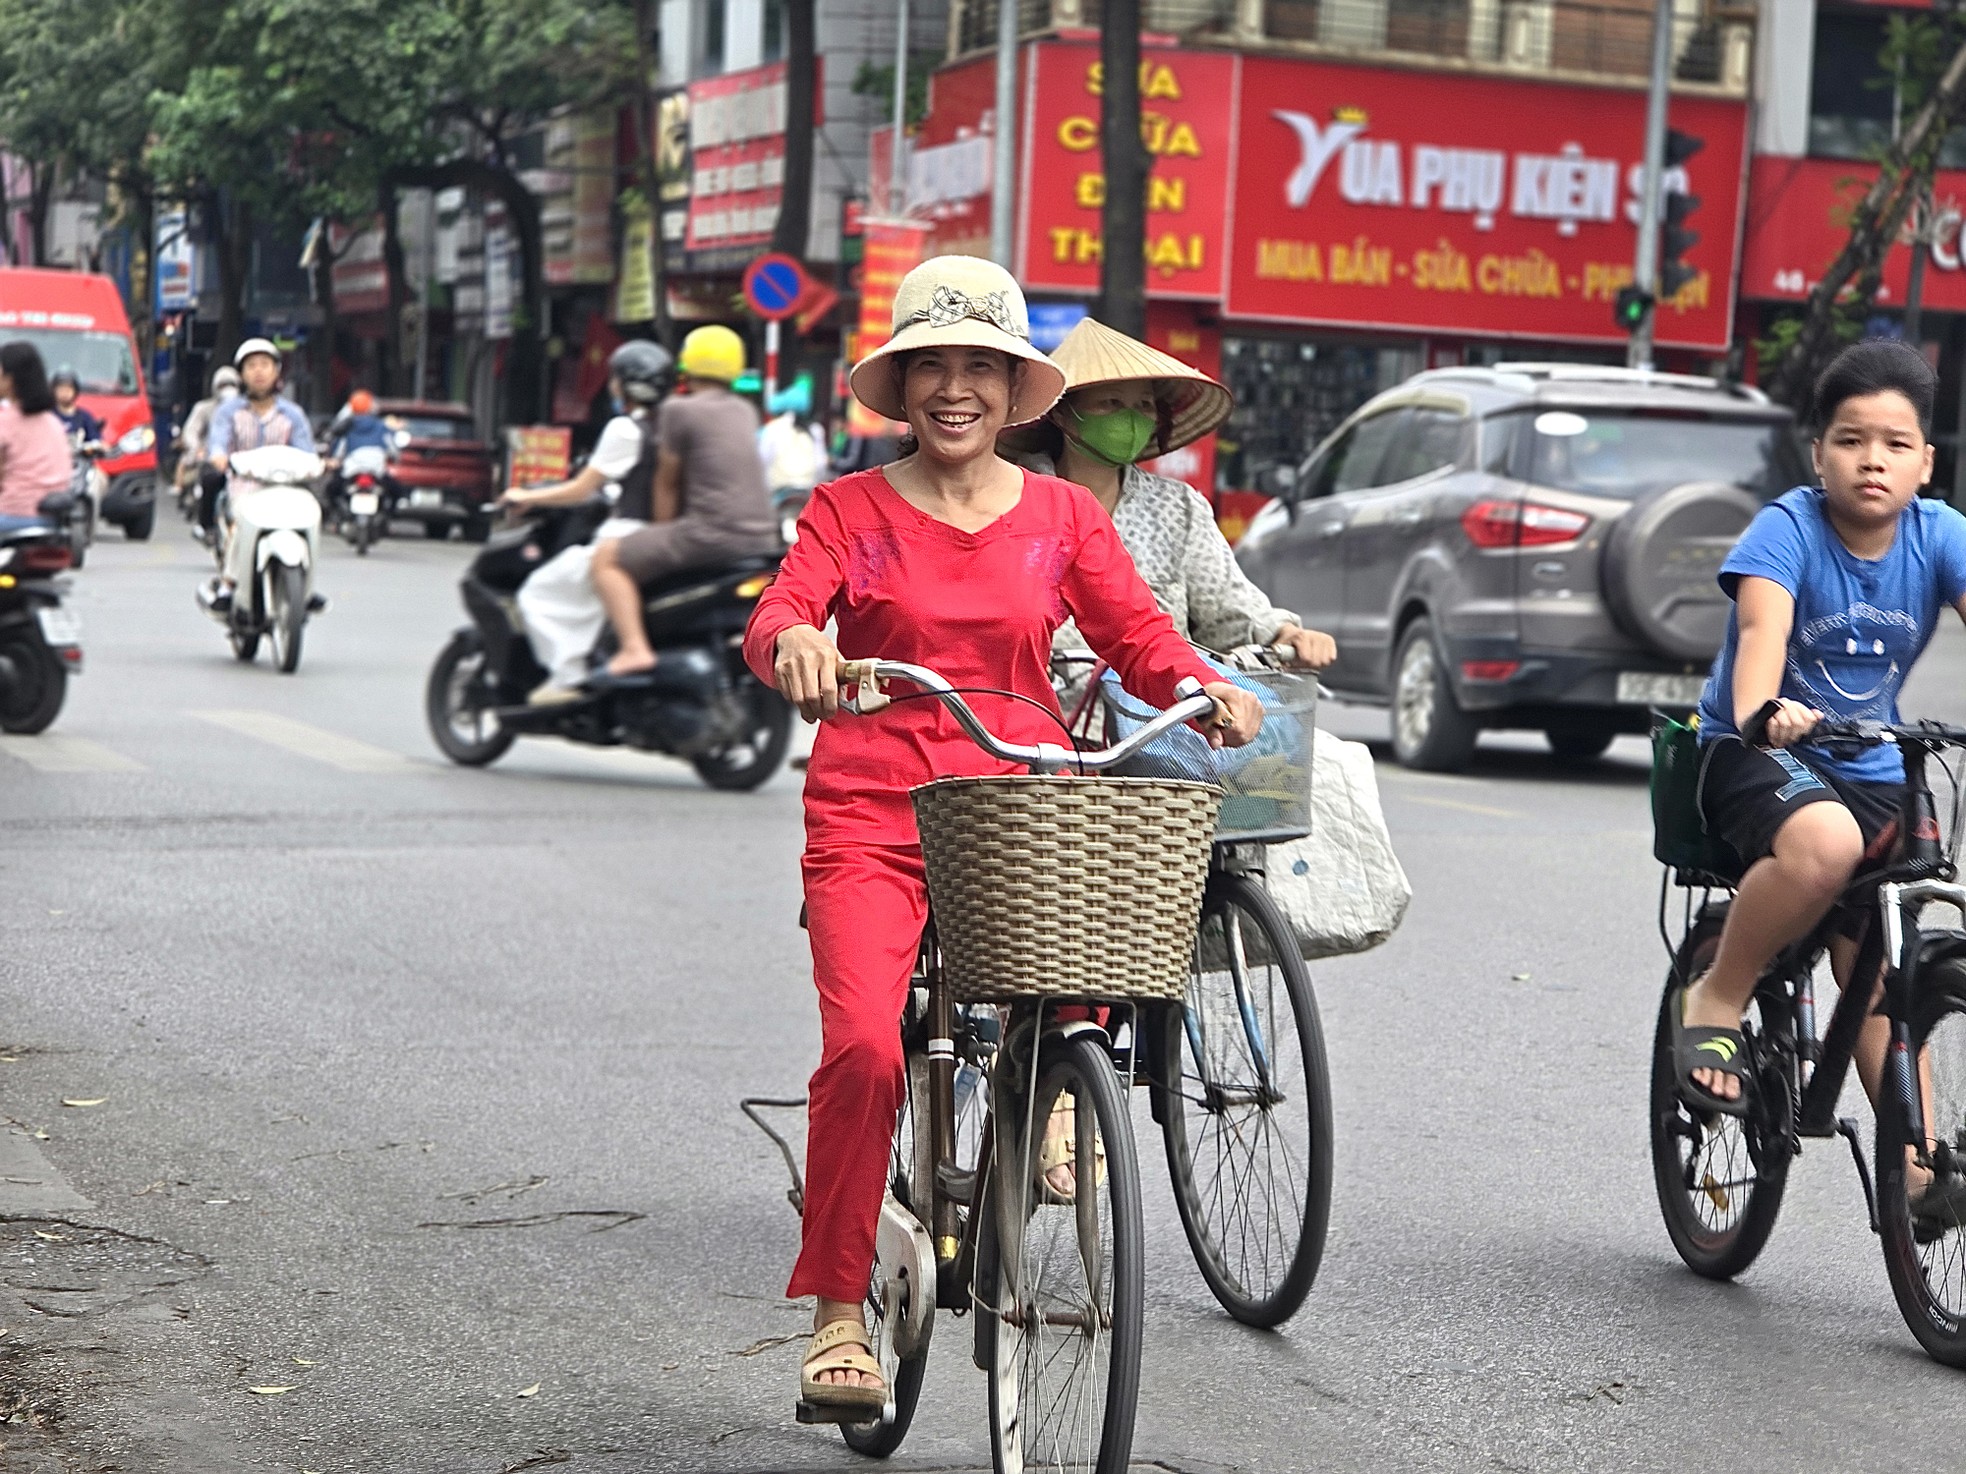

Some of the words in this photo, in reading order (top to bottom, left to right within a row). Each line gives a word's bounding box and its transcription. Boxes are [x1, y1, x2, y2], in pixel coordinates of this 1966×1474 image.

[1057, 110, 1202, 157] CỮA
[1075, 172, 1185, 212] ĐN
[1410, 145, 1506, 232] PHỤ
[1511, 140, 1619, 237] KIỆN
[1049, 226, 1204, 279] THẠI
[1256, 238, 1323, 282] MUA
[1328, 235, 1392, 286] BÁN
